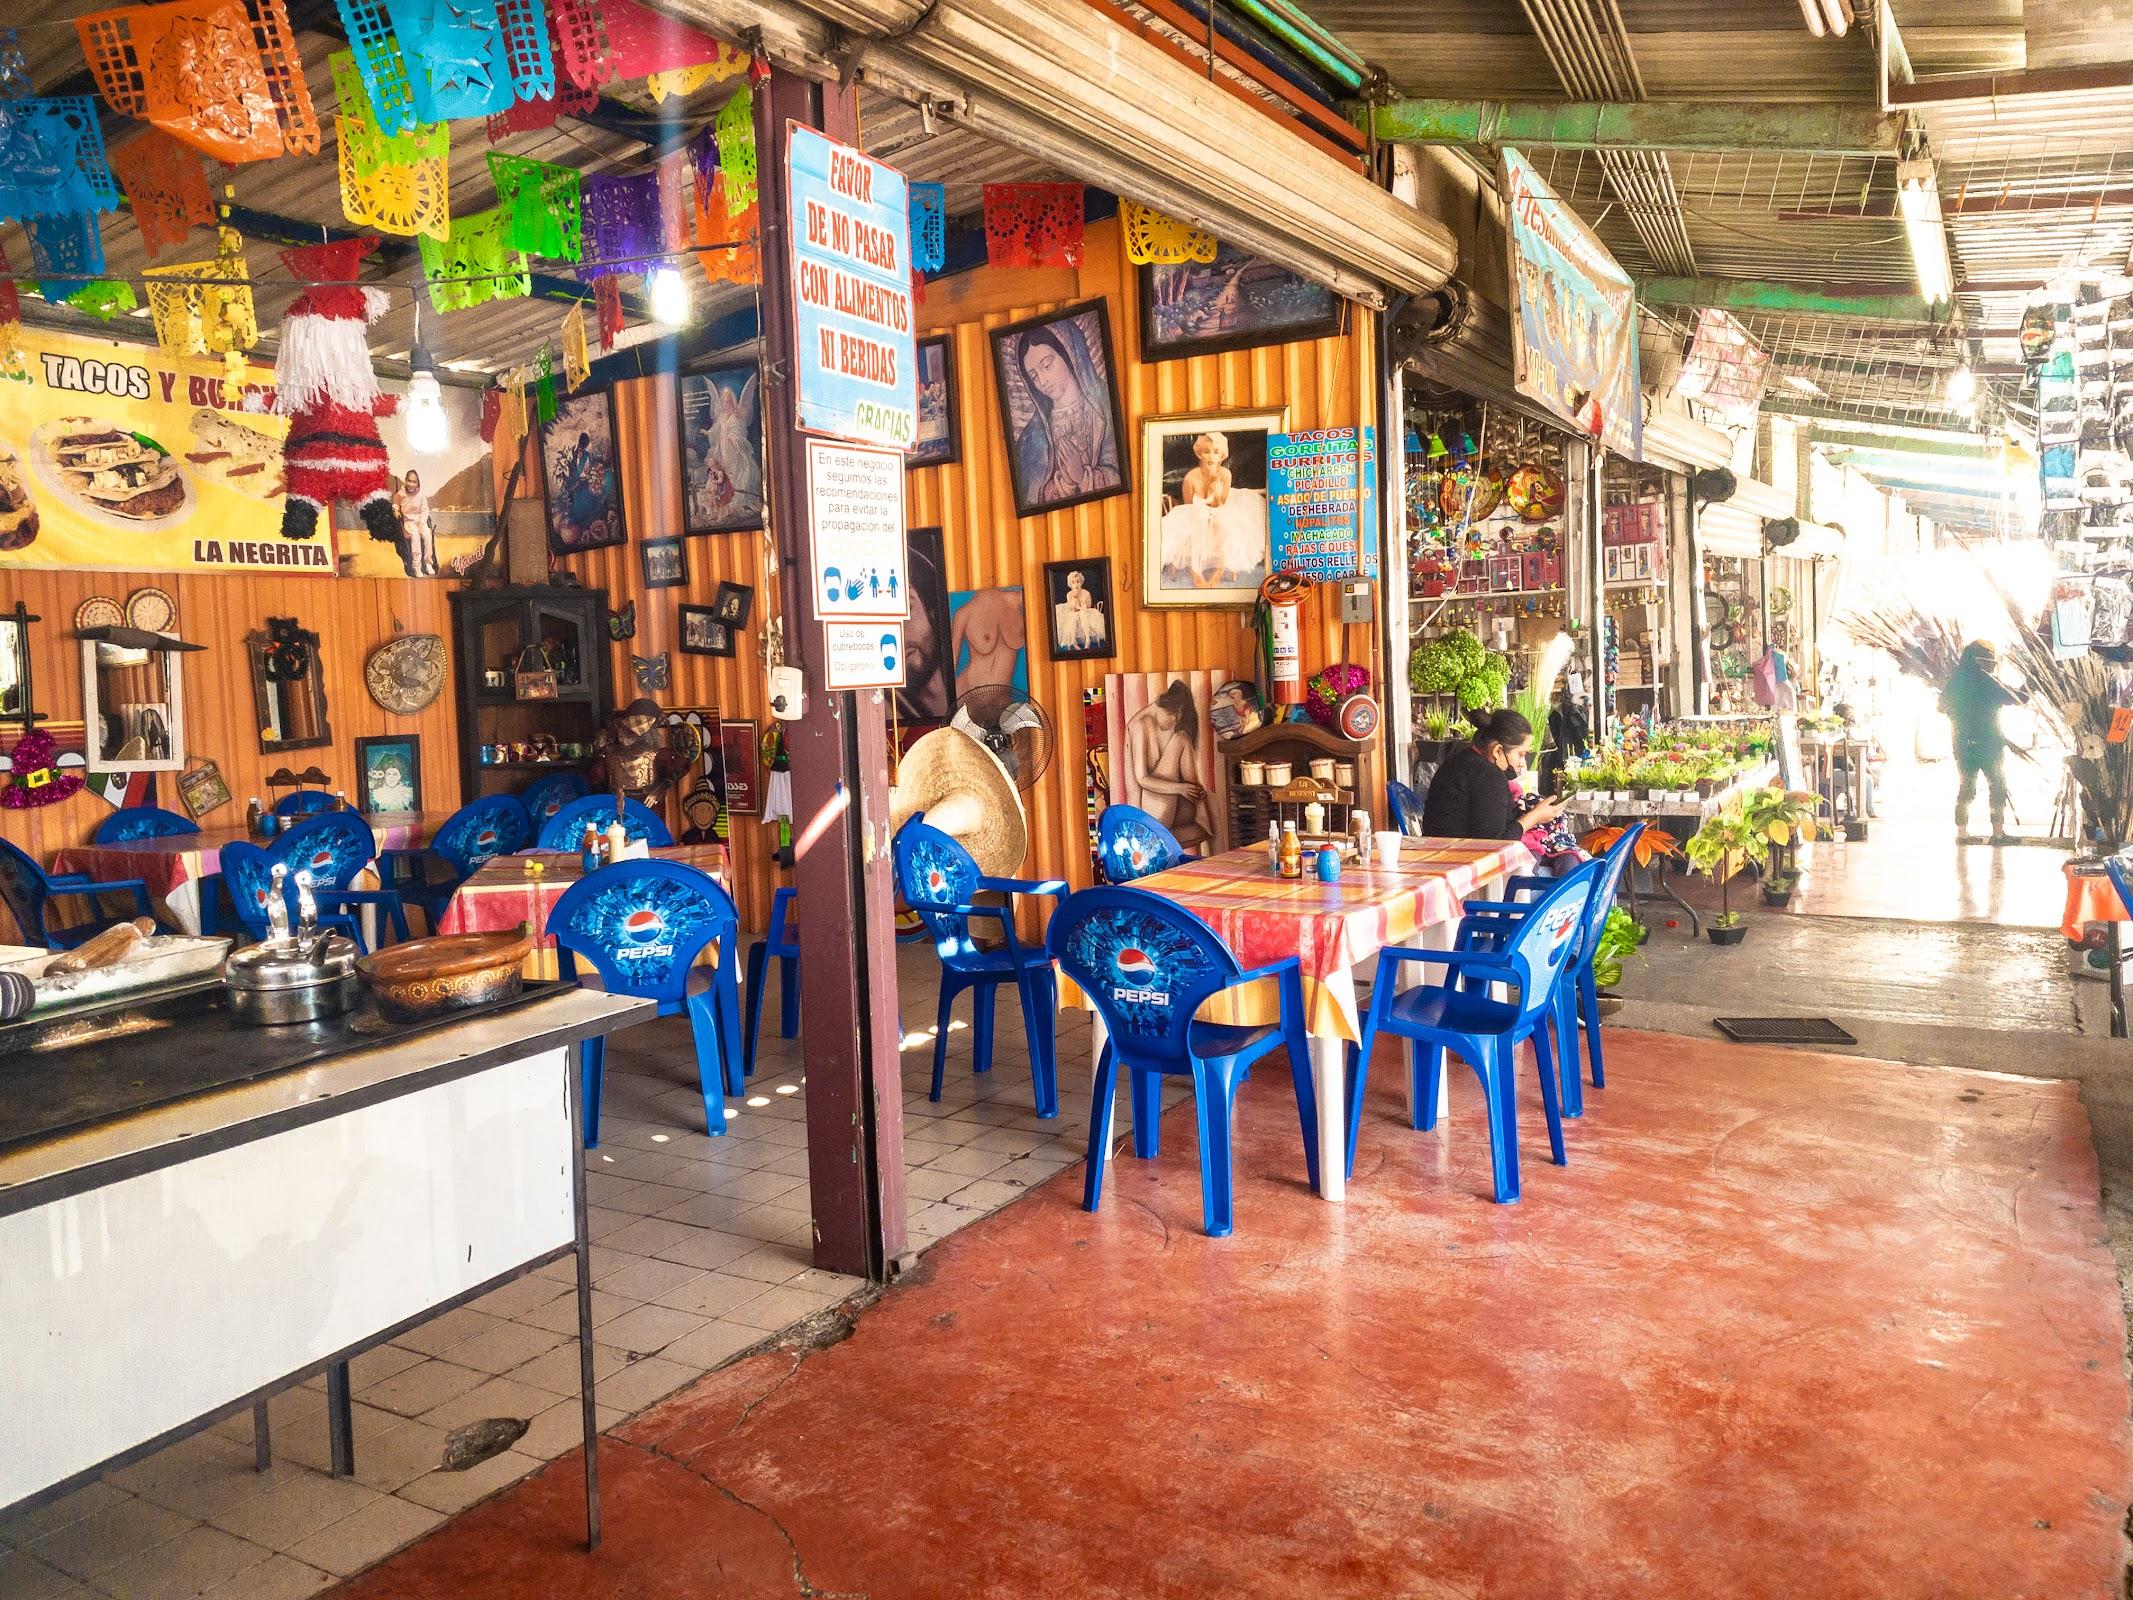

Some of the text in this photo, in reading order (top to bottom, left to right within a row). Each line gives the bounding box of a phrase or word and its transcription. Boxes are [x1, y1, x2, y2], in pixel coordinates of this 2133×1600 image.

[831, 151, 873, 205] FAVOR
[808, 201, 896, 272] DE NO PASAR
[801, 260, 908, 333] CON ALIMENTOS
[820, 327, 896, 386] NI BEBIDAS
[41, 353, 151, 400] TACOS
[159, 371, 177, 403] Y
[857, 402, 911, 444] GRACIAS
[1288, 428, 1354, 443] TACOS
[1270, 439, 1374, 457] GORDITAS
[819, 452, 894, 472] En este negocio
[1271, 452, 1373, 469] BURRITOS
[826, 472, 888, 485] seguimos las
[1294, 477, 1347, 491] PICADILLO
[816, 486, 898, 502] recomendaciones
[1277, 489, 1371, 505] ASADO DE PUERO
[828, 503, 888, 516] para evitar la
[1289, 502, 1356, 516] DESHEBRADA
[882, 521, 895, 533] del
[1295, 515, 1350, 529] NOPALITOS
[1291, 528, 1353, 542] MACHACADO
[194, 540, 328, 566] LA NEGRITA
[1286, 543, 1317, 555] RAJAS
[1281, 554, 1378, 570] CHILITOS RELLEOS
[1336, 568, 1369, 579] CARE
[310, 876, 337, 888] EPSI
[616, 944, 674, 961] PEPSI
[1113, 987, 1170, 1006] PEPSI
